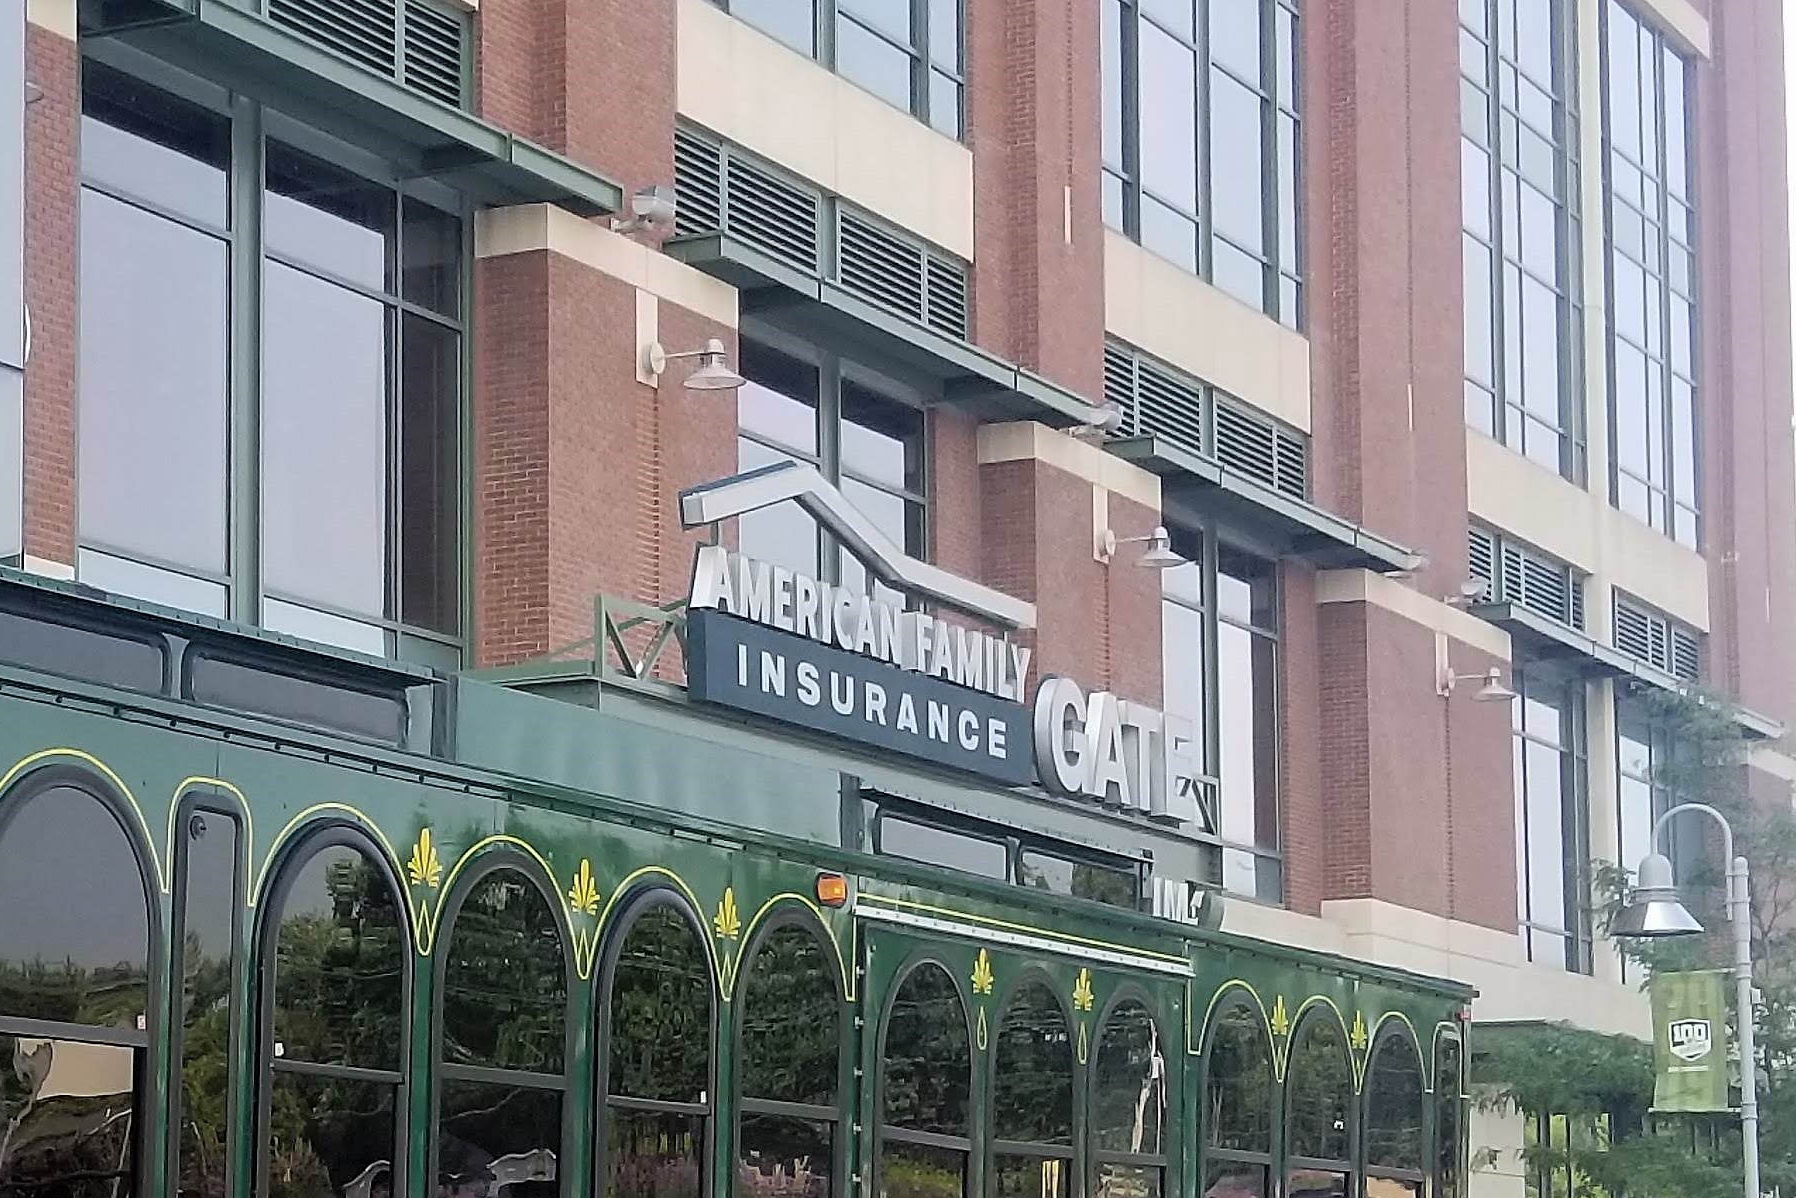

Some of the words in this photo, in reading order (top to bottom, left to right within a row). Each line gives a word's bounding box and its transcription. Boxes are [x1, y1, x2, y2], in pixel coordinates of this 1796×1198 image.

[690, 545, 905, 668] AMERICAN
[902, 611, 1032, 703] FAMILY
[738, 643, 1008, 759] INSURANCE
[1034, 678, 1194, 824] GATE
[1672, 1023, 1707, 1043] 100
